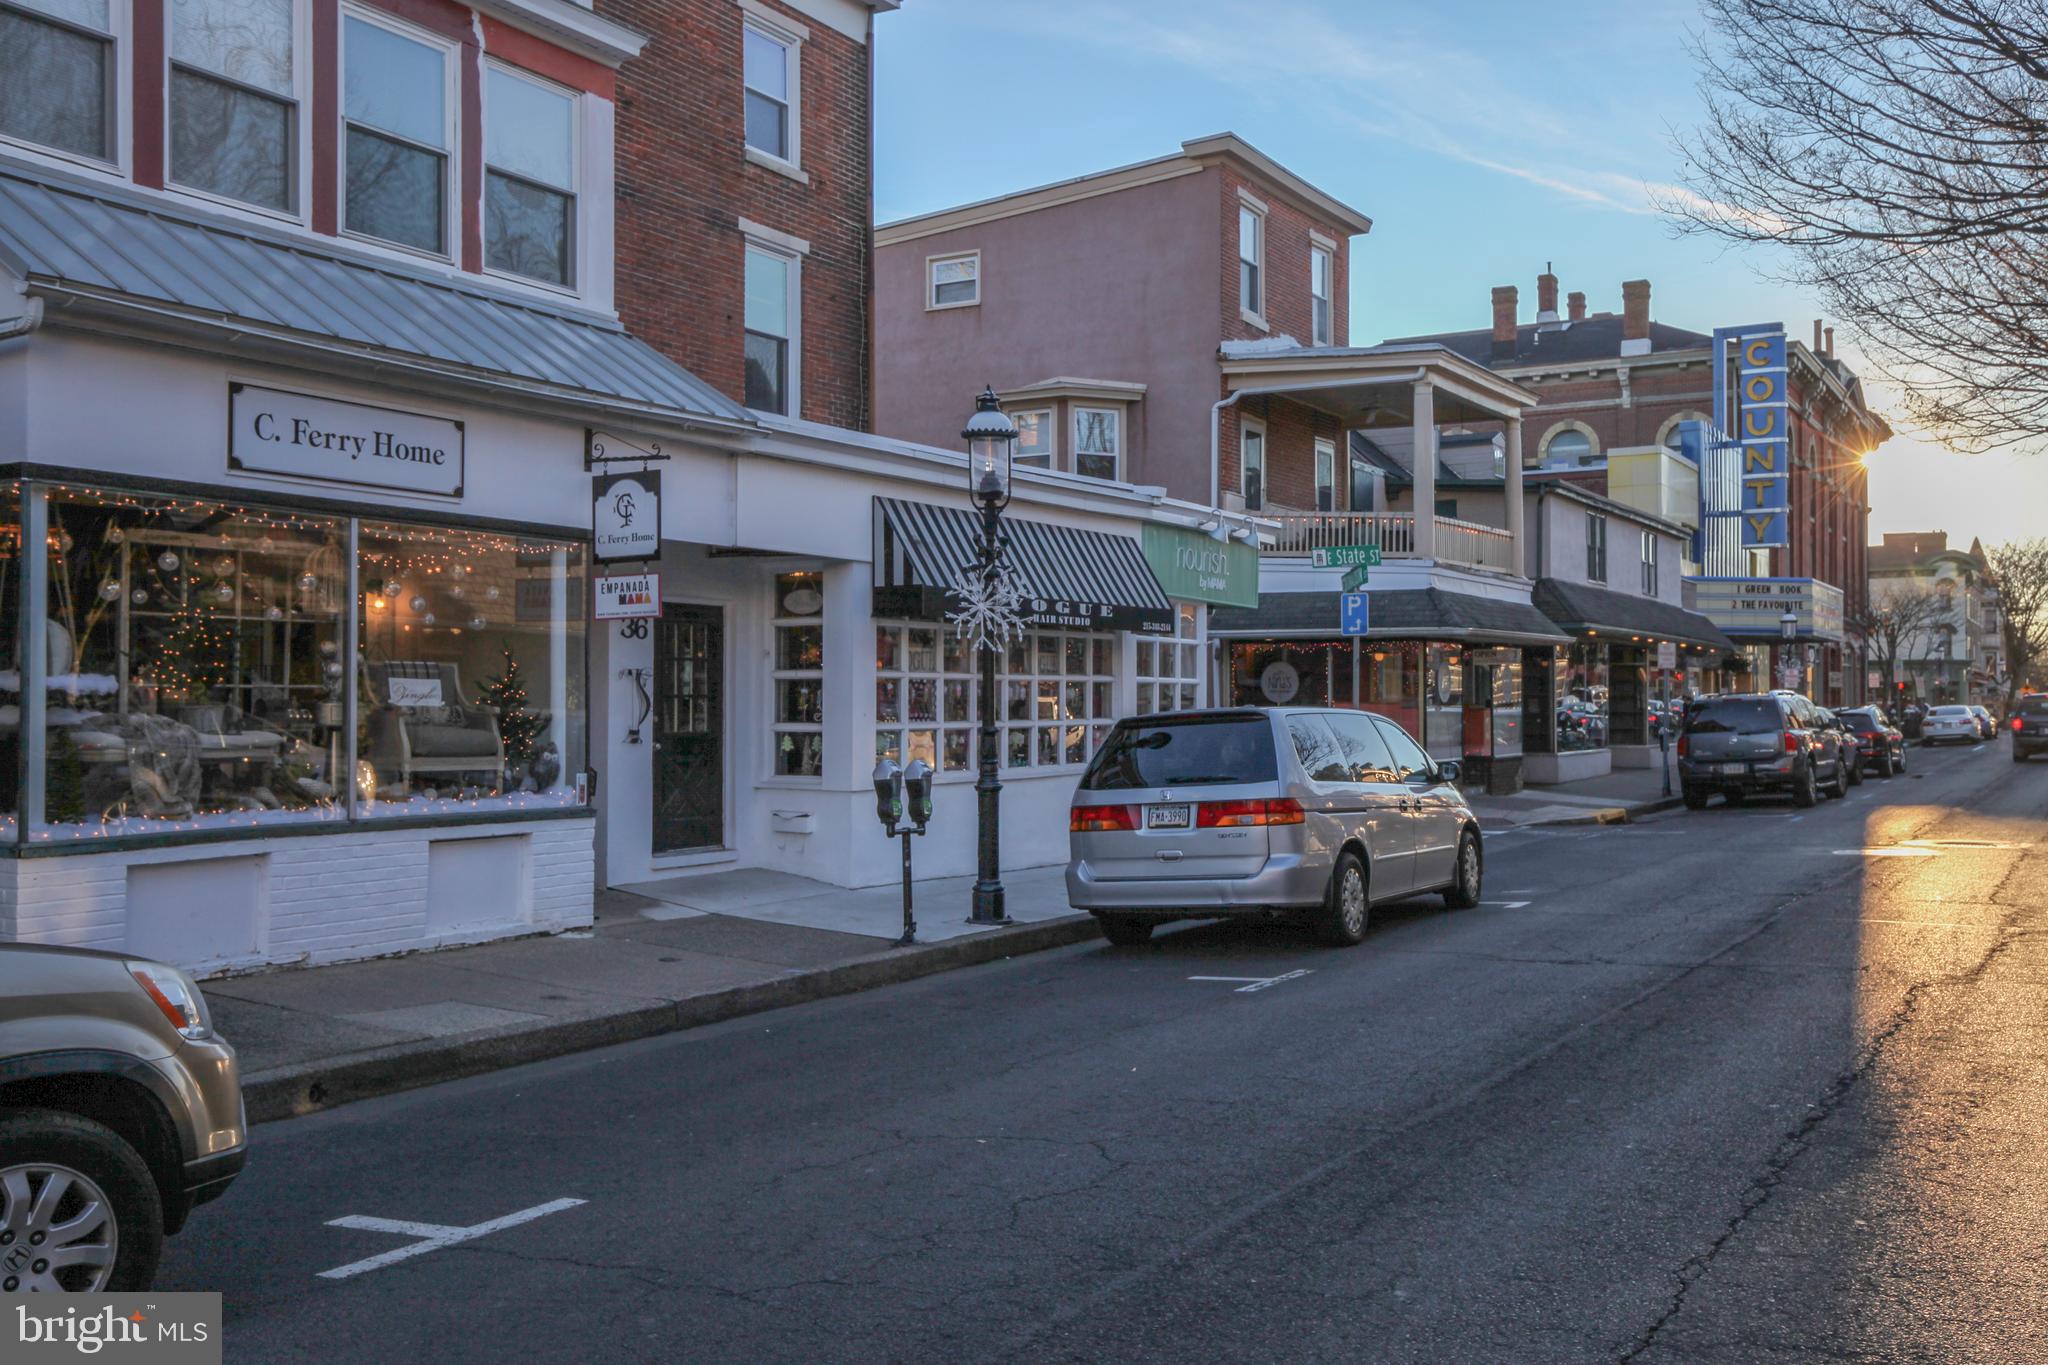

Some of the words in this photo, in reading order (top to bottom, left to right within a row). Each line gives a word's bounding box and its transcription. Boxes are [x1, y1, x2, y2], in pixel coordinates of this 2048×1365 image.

[254, 412, 281, 442] C.
[290, 417, 366, 460] Ferry
[372, 431, 446, 465] Home
[1746, 340, 1775, 543] COUNTY
[597, 535, 606, 545] C.
[608, 534, 629, 545] Ferry
[631, 532, 655, 542] Home
[1328, 551, 1332, 565] E
[1336, 548, 1365, 565] State
[601, 580, 650, 595] EMPANADA
[1200, 574, 1207, 591] by
[1745, 584, 1771, 594] GREEN
[1779, 585, 1802, 594] BOOK
[619, 592, 651, 606] MAMA
[1347, 595, 1362, 617] P
[1741, 600, 1756, 609] THE
[1758, 600, 1803, 610] FAVOURITE
[1033, 614, 1057, 624] HAIR
[1058, 615, 1091, 626] STUDIO
[620, 617, 648, 640] 36
